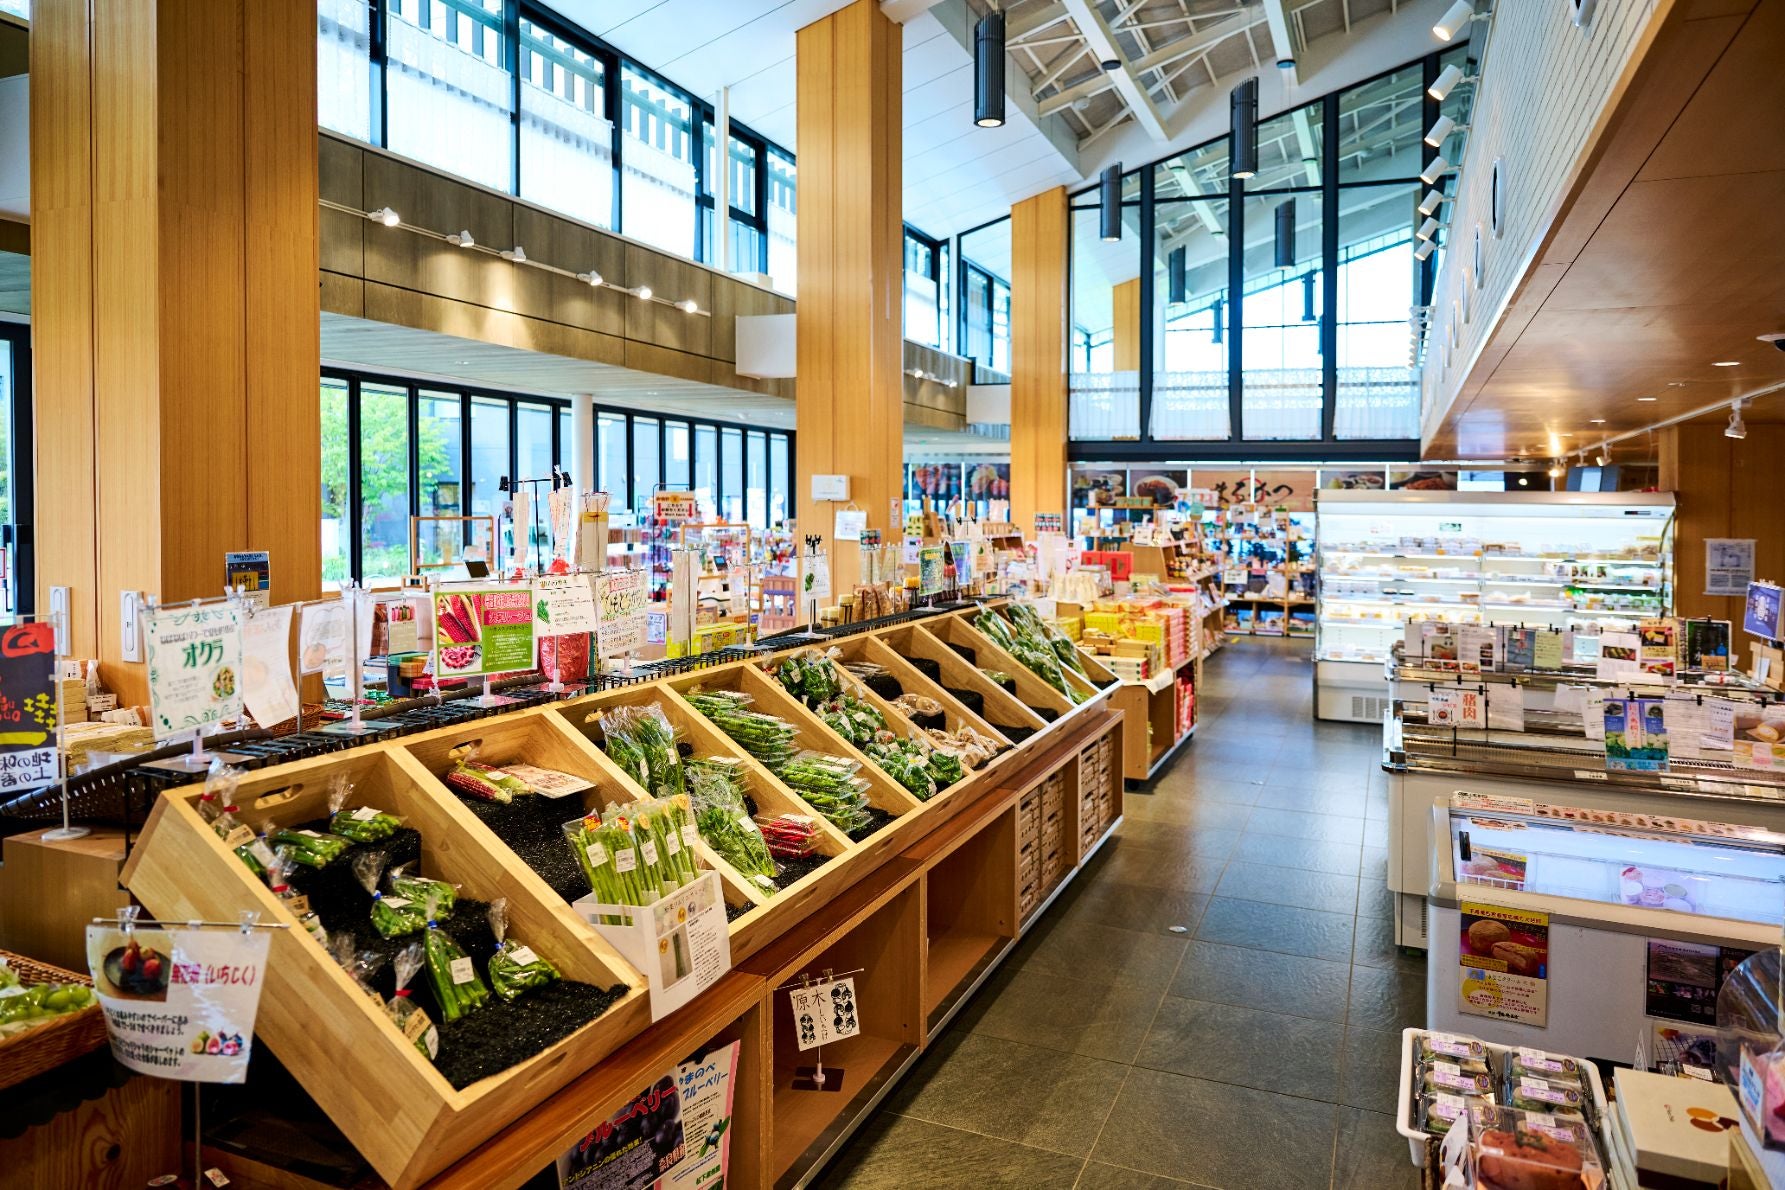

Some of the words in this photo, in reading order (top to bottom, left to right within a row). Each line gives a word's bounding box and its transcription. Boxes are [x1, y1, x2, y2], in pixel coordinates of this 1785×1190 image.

[182, 638, 224, 668] オクラ
[1462, 693, 1477, 720] 猪肉
